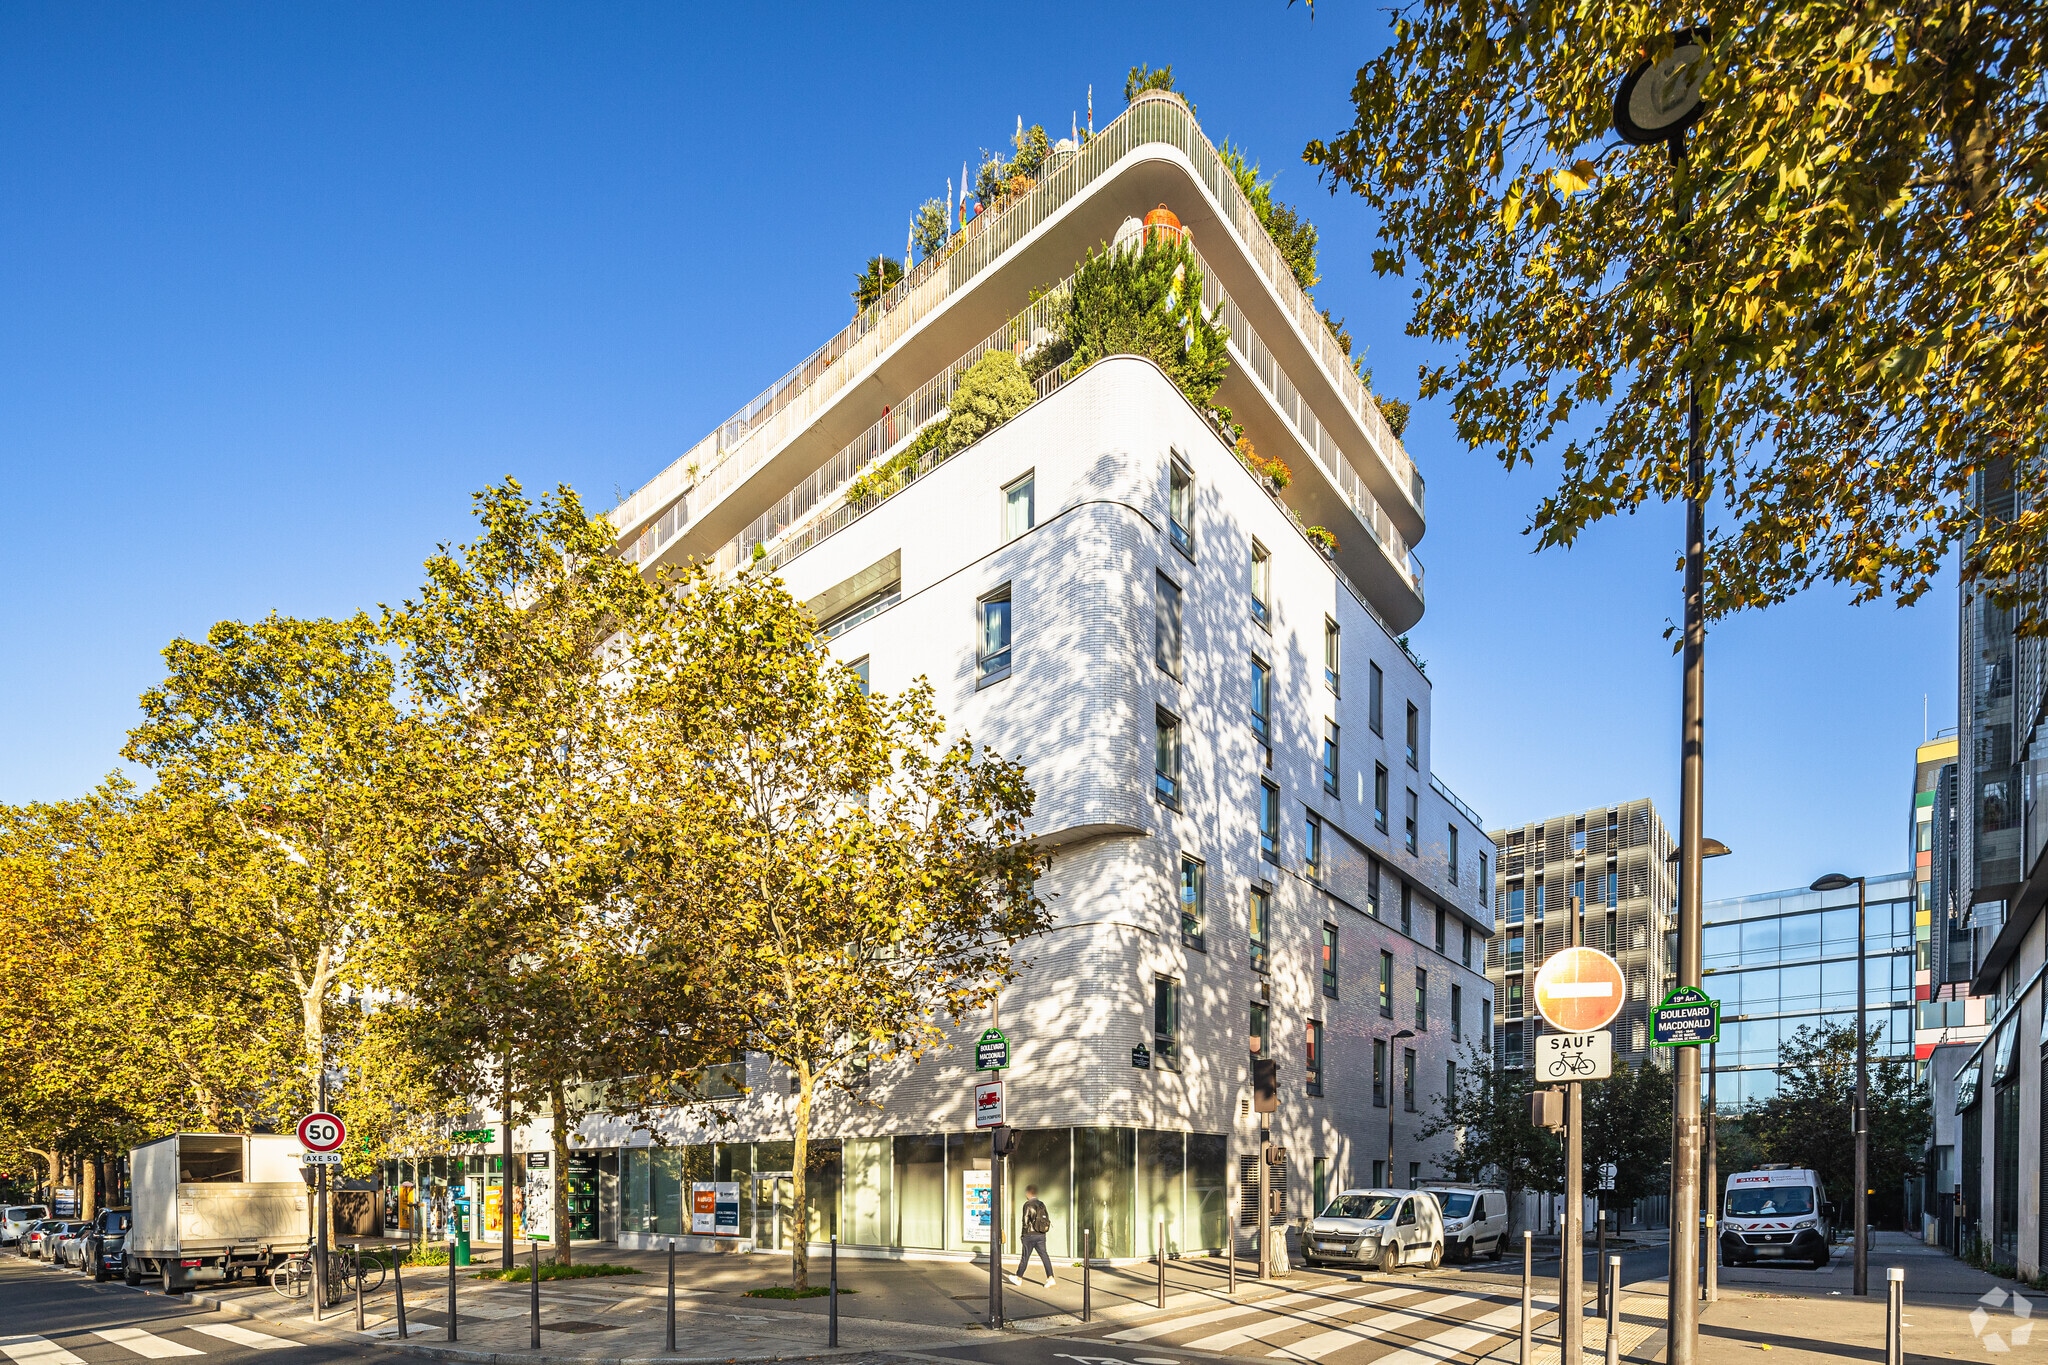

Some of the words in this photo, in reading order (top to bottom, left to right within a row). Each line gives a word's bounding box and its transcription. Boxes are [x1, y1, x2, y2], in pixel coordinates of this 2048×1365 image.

[1660, 1007, 1710, 1020] BOULEVARD
[1658, 1019, 1710, 1031] MACDONALD
[980, 1043, 1004, 1052] BOULEVARD
[1550, 1036, 1595, 1050] SAUF
[980, 1051, 1005, 1060] MACDONALD
[309, 1125, 335, 1140] 50
